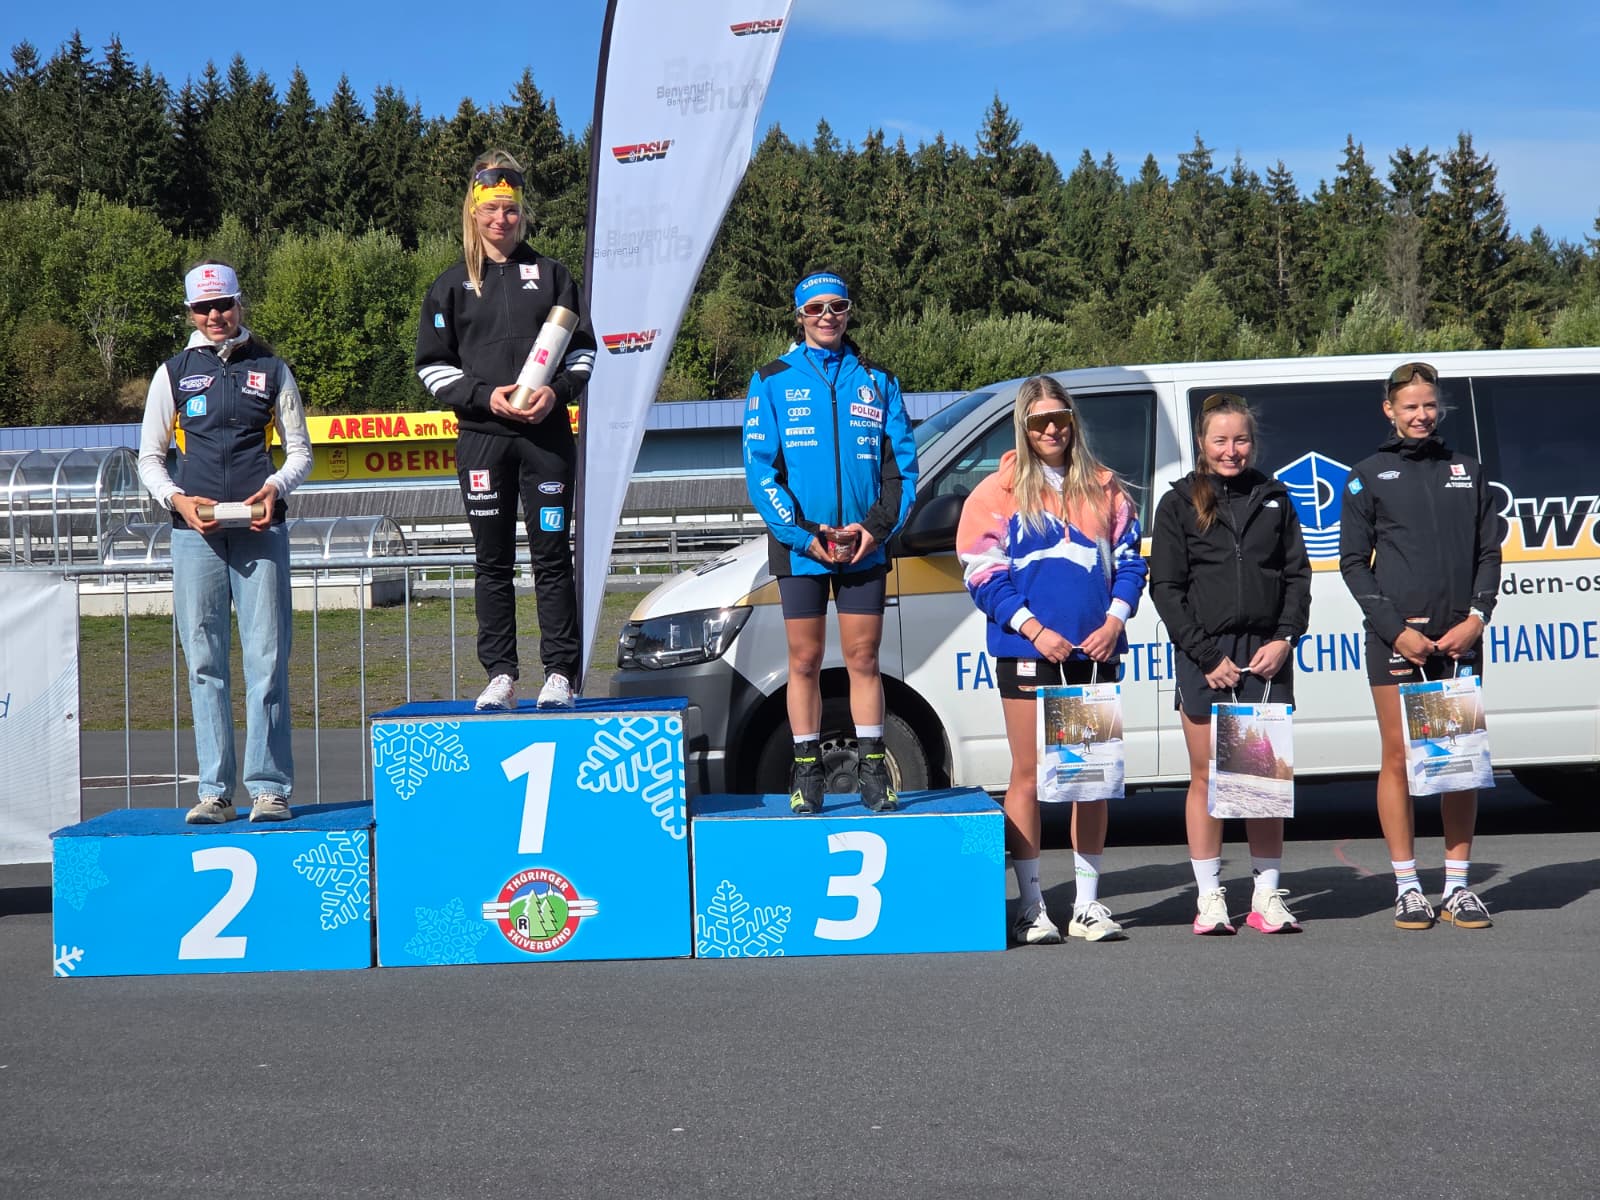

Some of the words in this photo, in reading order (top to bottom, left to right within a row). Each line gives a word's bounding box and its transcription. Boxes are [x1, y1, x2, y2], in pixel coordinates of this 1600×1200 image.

[785, 388, 810, 399] EA7
[852, 404, 881, 420] POLIZIA
[328, 416, 411, 440] ARENA
[414, 422, 438, 437] am
[442, 419, 460, 436] Re
[365, 449, 458, 473] OBERH
[466, 491, 499, 501] Kaufland
[764, 487, 793, 524] Audi
[544, 510, 561, 529] TQ
[956, 651, 994, 691] FA
[1296, 632, 1361, 673] CHN
[1490, 620, 1600, 664] HANDE
[500, 742, 557, 855] 1
[506, 870, 569, 893] THÜRINGER
[813, 830, 888, 941] 3
[178, 846, 258, 961] 2
[518, 918, 529, 931] R
[507, 927, 572, 952] SKIVERBAND
